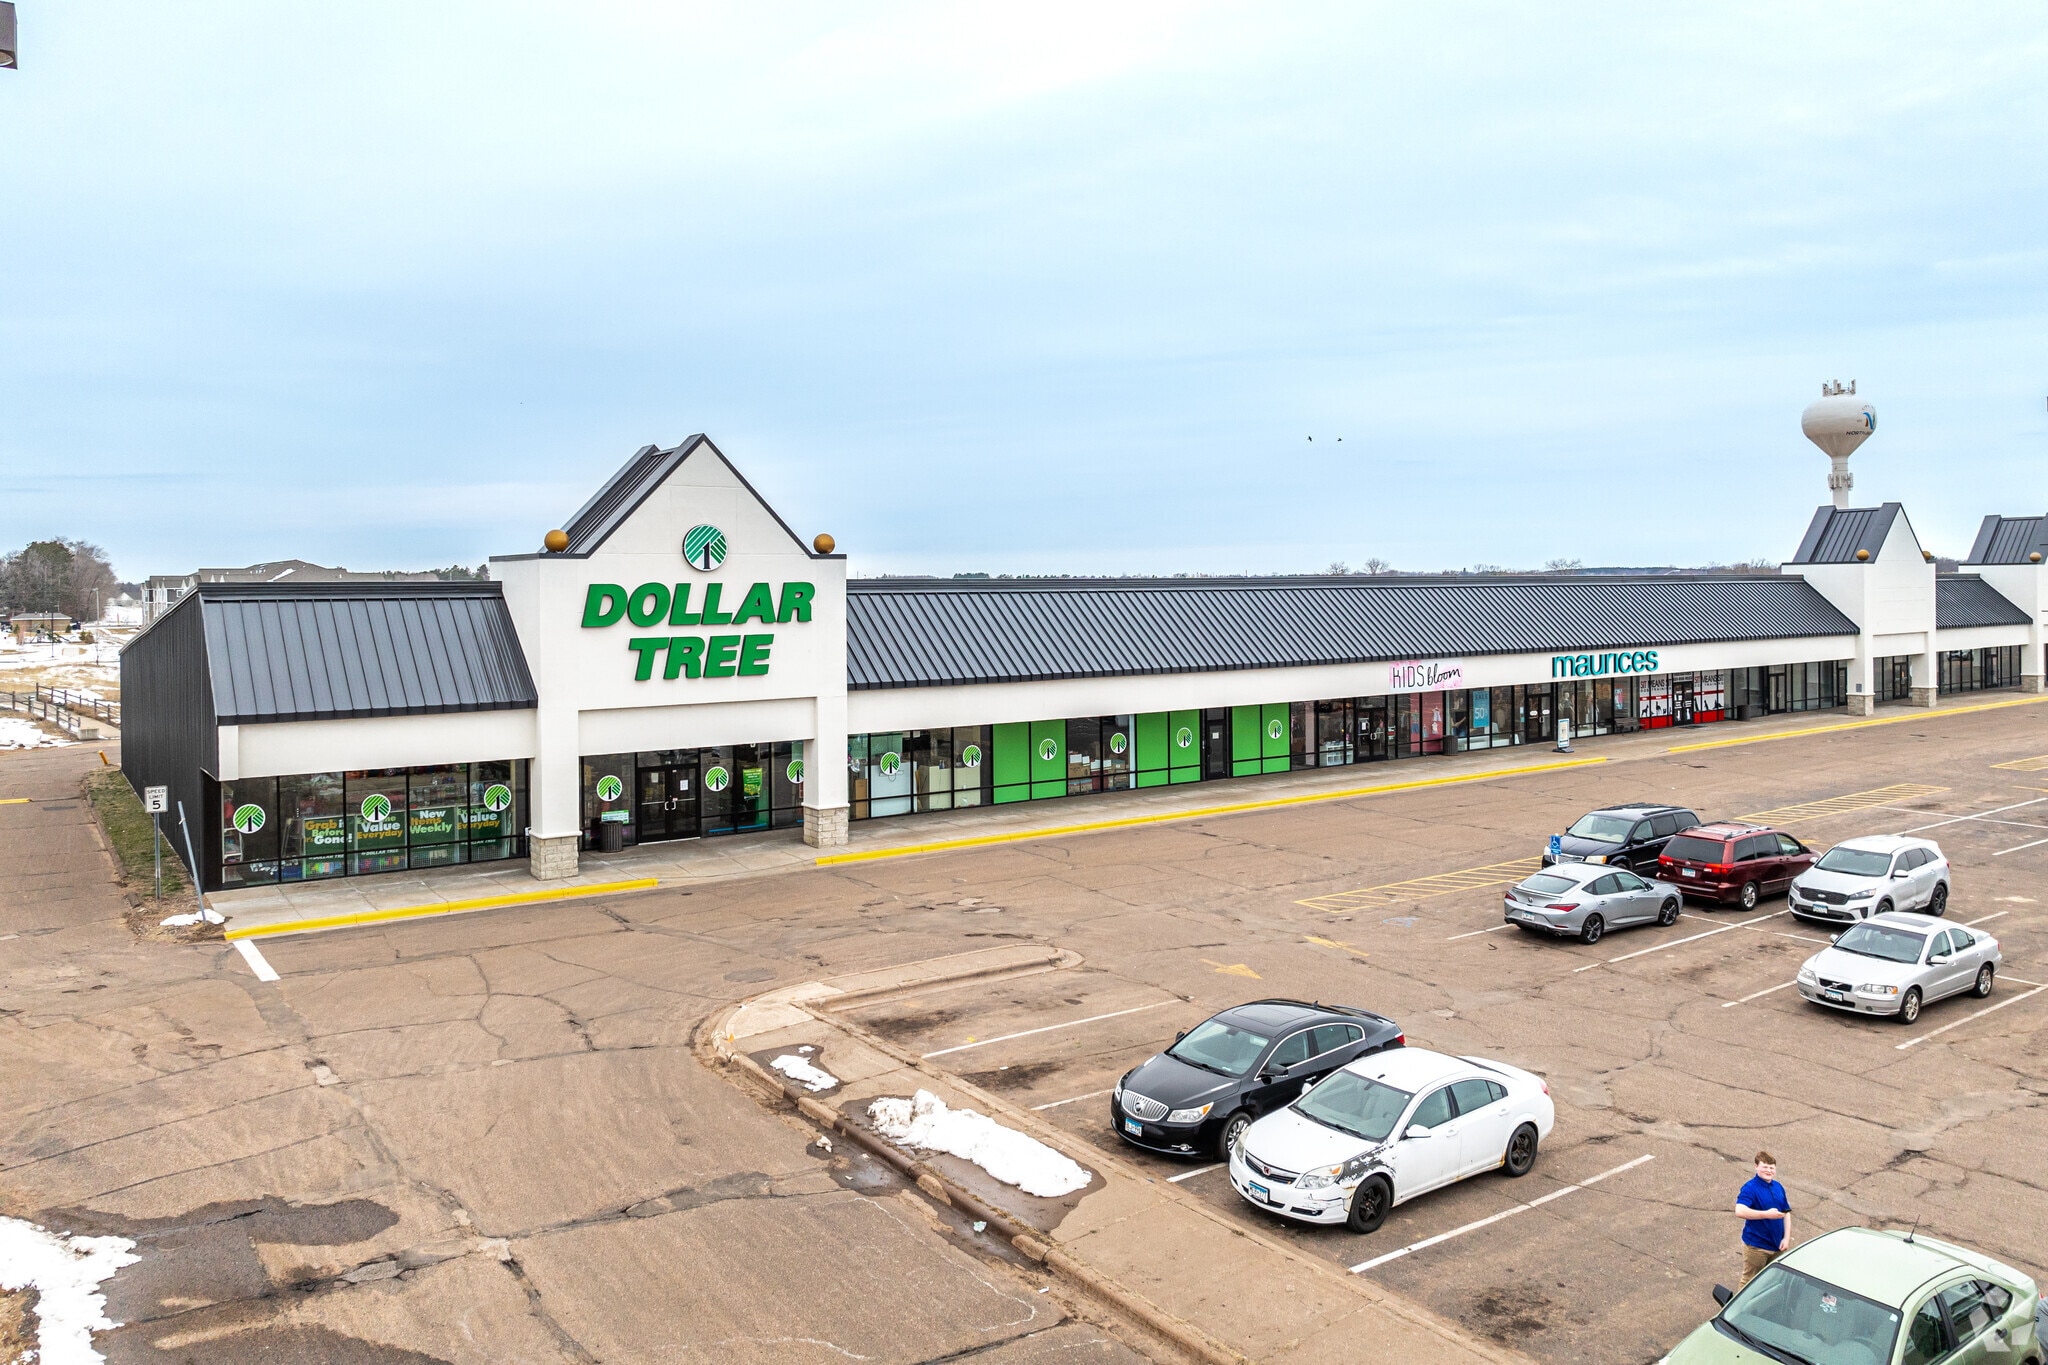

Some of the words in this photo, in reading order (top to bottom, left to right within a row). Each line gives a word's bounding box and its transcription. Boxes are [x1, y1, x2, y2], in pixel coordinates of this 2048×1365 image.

[581, 581, 816, 628] DOLLAR
[628, 633, 775, 681] TREE
[1552, 650, 1659, 678] maurices
[1392, 665, 1425, 689] KIDS
[1427, 663, 1461, 686] bloom
[152, 800, 161, 810] 5
[419, 810, 446, 819] New
[305, 819, 338, 831] Grab
[361, 820, 401, 833] Value
[409, 822, 453, 834] Weekly
[357, 829, 404, 840] Everyday
